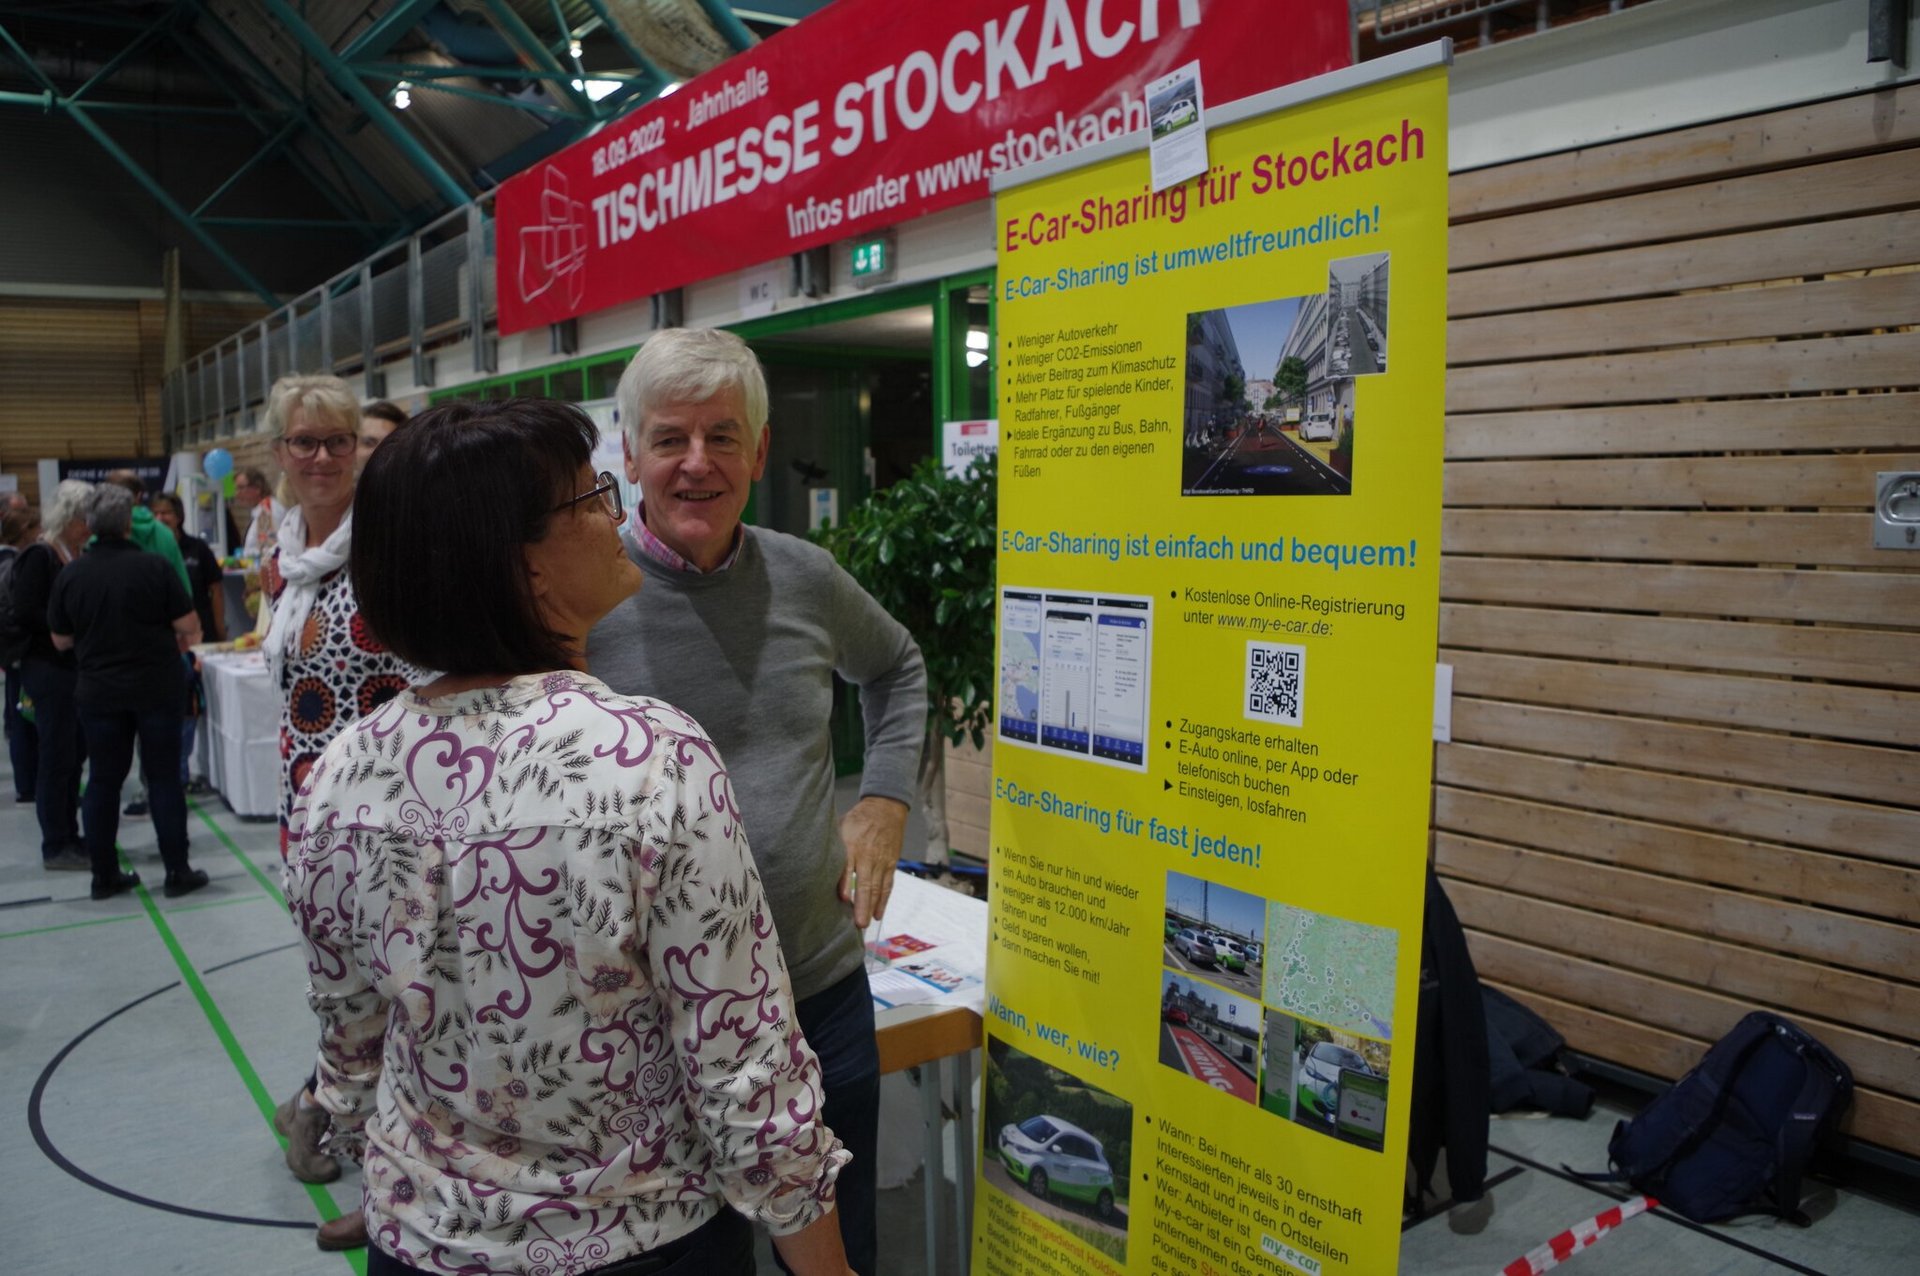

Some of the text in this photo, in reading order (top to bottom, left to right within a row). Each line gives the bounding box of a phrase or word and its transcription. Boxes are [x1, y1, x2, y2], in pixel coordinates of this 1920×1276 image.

[686, 67, 769, 131] Jahnhalle
[592, 100, 820, 249] TISCHMESSE
[1006, 183, 1187, 252] E-Car-Sharing
[1197, 165, 1242, 207] für
[1252, 118, 1424, 194] Stockach
[786, 196, 842, 238] Infos
[847, 174, 910, 220] unter
[1006, 205, 1380, 301] E-Car-Sharing ist umweltfreundlich!
[1017, 323, 1118, 348] Weniger Autoverkehr
[1017, 340, 1142, 366] Weniger CO2-Emissionen
[1016, 356, 1176, 385] Aktiver Beitrag zum Klimaschutz
[1016, 378, 1174, 403] Mehr Platz für spielende Kinder,
[1014, 419, 1172, 442] Ideale Ergänzung zu Bus, Bahn,
[1015, 403, 1120, 422] Radfahrer, Fußgänger
[1014, 442, 1154, 459] Fahrrad oder zu den eigenen
[1014, 465, 1041, 478] Füßen
[1003, 531, 1417, 571] E-Car-Sharing ist einfach und bequem!
[1184, 611, 1334, 636] unter www.my-e-car.de:
[1185, 587, 1405, 620] Kostenlose Online-Registrierung
[1180, 718, 1319, 756] Zugangskarte erhalten
[1178, 761, 1290, 796] telefonisch buchen
[1179, 739, 1359, 786] E-Auto online, per App oder
[996, 777, 1261, 868] E-Car-Sharing für fast jeden!
[1179, 781, 1306, 823] Einsteigen, losfahren
[1003, 866, 1105, 909] ein Auto brauchen und
[1004, 848, 1139, 900] Wenn Sie nur hin und wieder
[1002, 900, 1047, 927] fahren und
[1003, 884, 1130, 937] weniger als 12.000 km/Jahr
[1002, 917, 1091, 964] Geld sparen wollen,
[1002, 936, 1101, 984] dann machen Sie mit!
[988, 992, 1120, 1072] Wann, wer, wie?
[1157, 1137, 1323, 1230] Interessierten jeweils in der
[1158, 1117, 1363, 1225] Wann: Bei mehr als 30 ernsthaft
[1155, 1195, 1204, 1232] My-e-car
[1206, 1223, 1220, 1241] ist
[1223, 1236, 1241, 1254] ein
[1156, 1157, 1349, 1265] Kernstadt und in den Ortsteilen
[1185, 1192, 1233, 1228] Anbieter
[1237, 1222, 1252, 1239] ist
[1262, 1236, 1321, 1273] my-e-car
[1153, 1233, 1198, 1270] Pioniers
[1154, 1217, 1228, 1267] unternehmen
